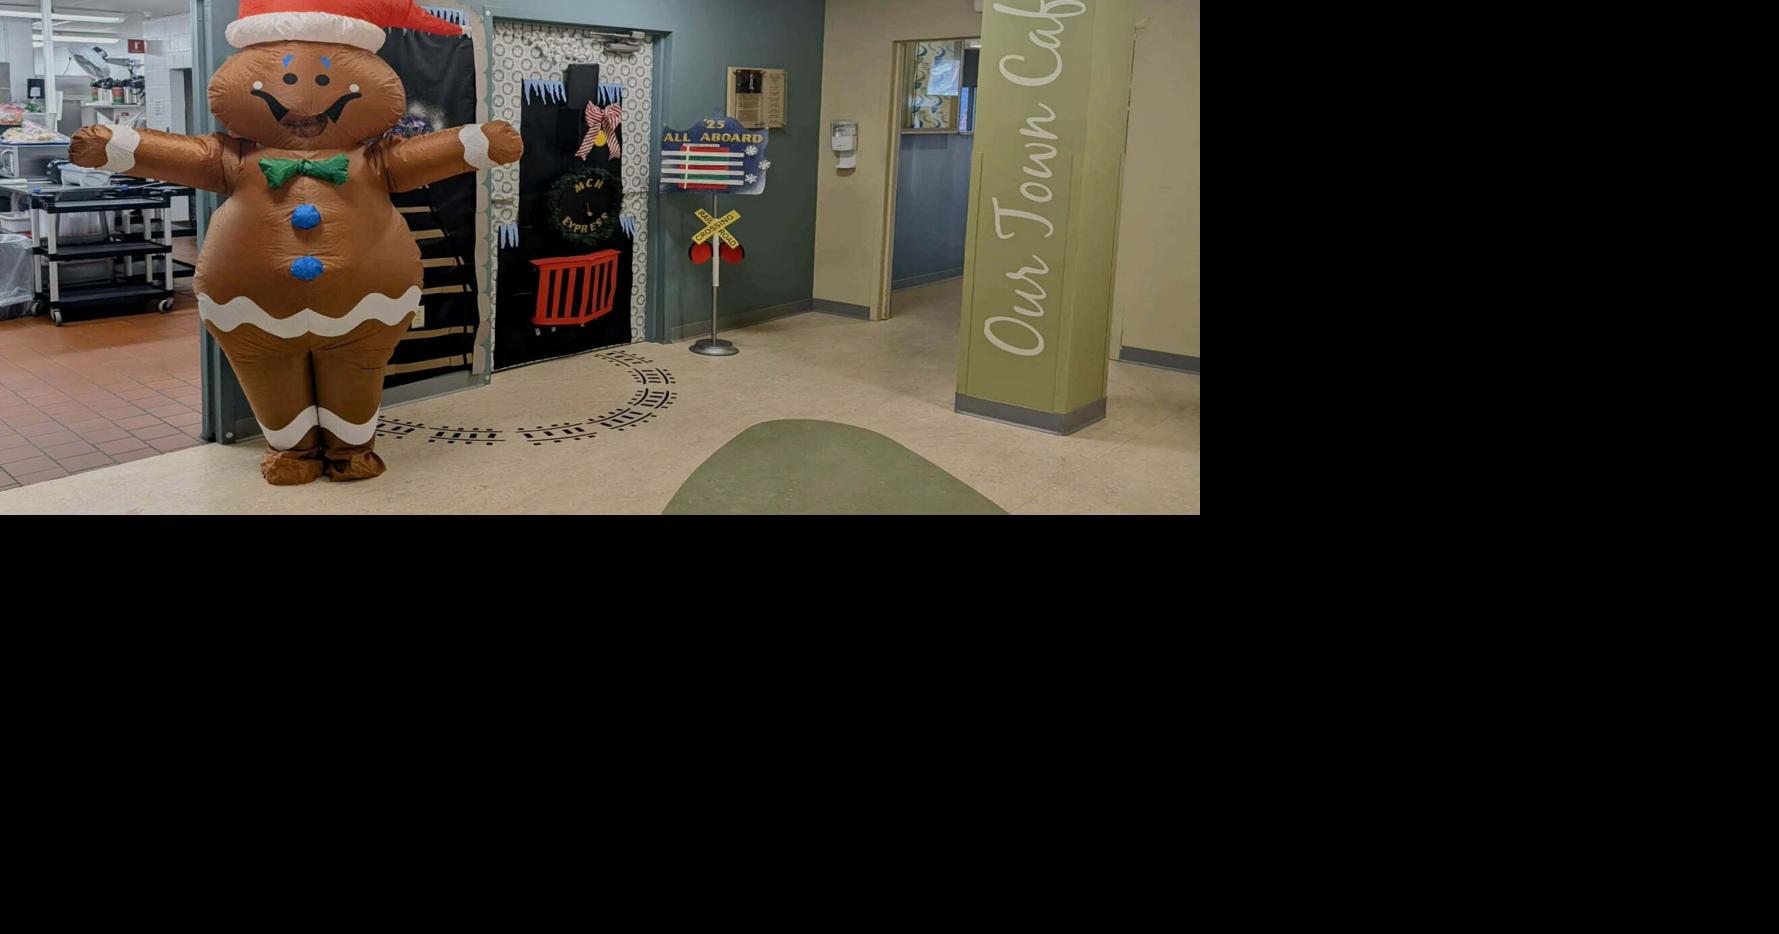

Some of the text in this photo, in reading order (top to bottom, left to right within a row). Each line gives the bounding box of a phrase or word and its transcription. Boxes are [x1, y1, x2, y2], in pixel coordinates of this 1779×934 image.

[663, 132, 764, 143] ALL ABOARD
[992, 103, 1058, 239] Town
[575, 178, 604, 193] MCH
[562, 211, 608, 233] EXPRESS
[695, 214, 734, 241] CROSSING
[698, 211, 737, 247] RAIL ROAD
[984, 255, 1049, 356] Our
